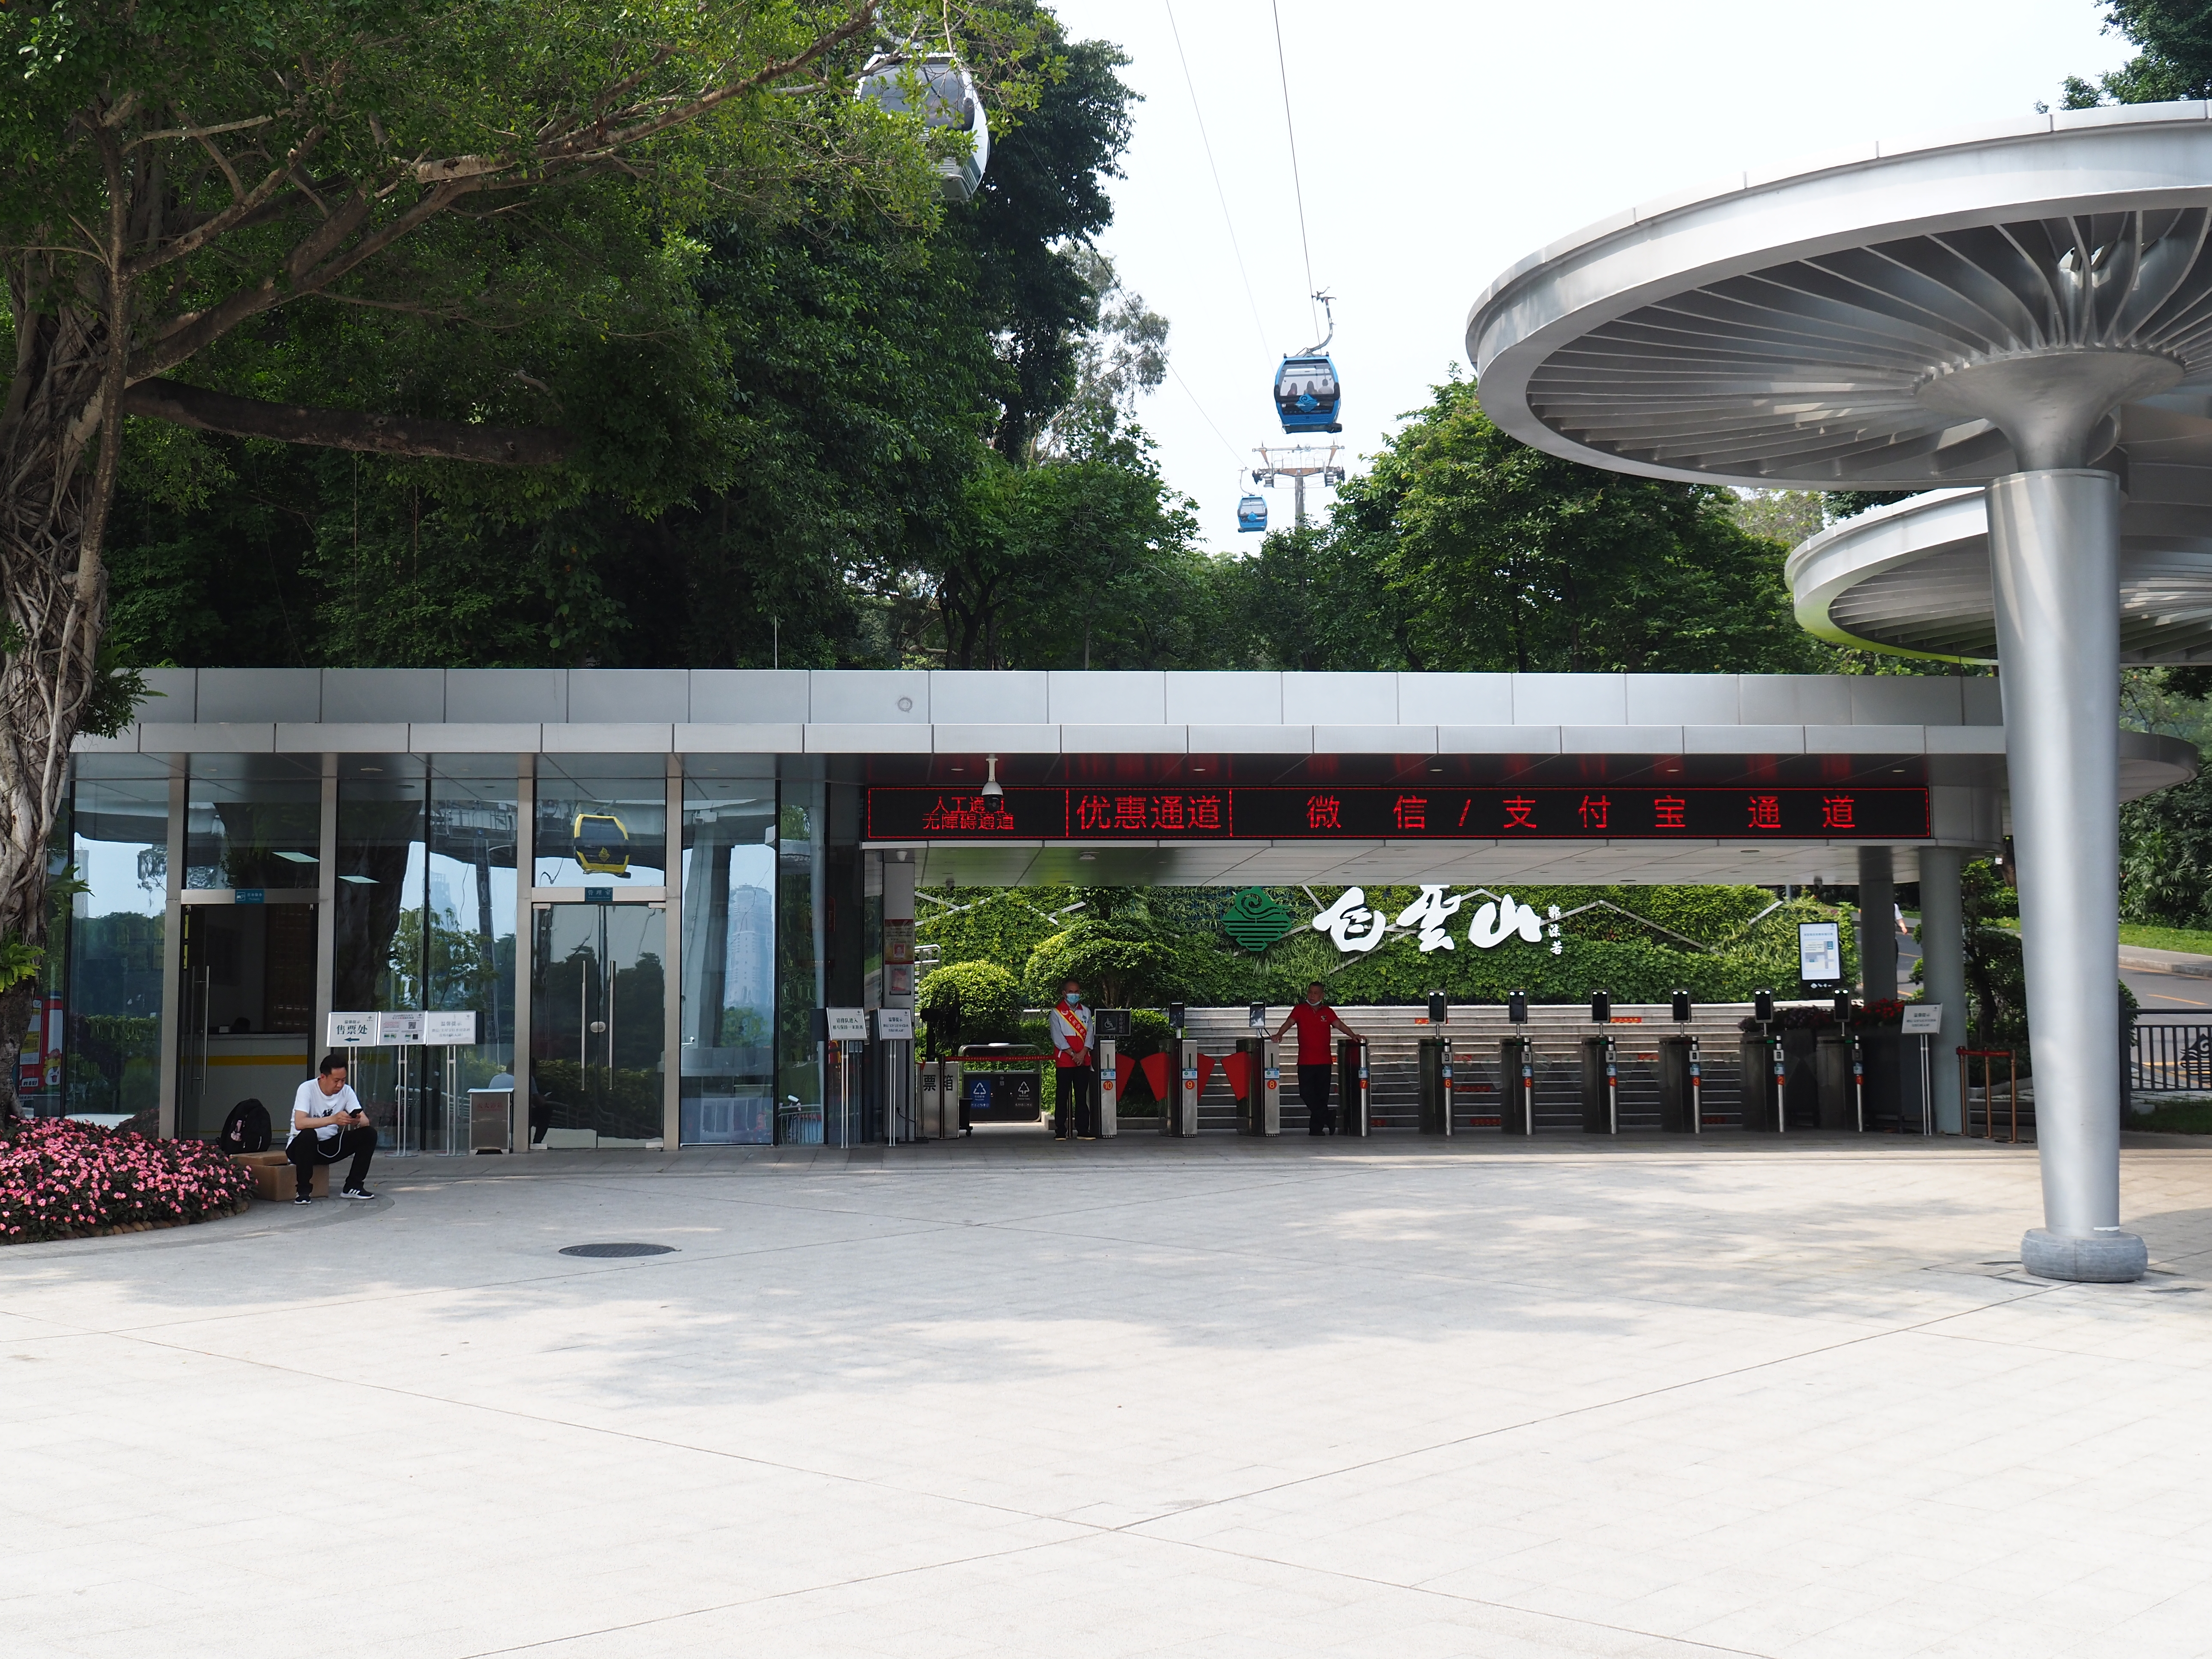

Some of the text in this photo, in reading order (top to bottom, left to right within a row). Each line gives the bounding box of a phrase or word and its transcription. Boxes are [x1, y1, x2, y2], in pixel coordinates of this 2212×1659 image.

[1076, 795, 1221, 829] 优惠通道
[923, 812, 1014, 830] 无障碍通道
[336, 1025, 368, 1035] 售票处
[923, 1074, 953, 1091] 票箱
